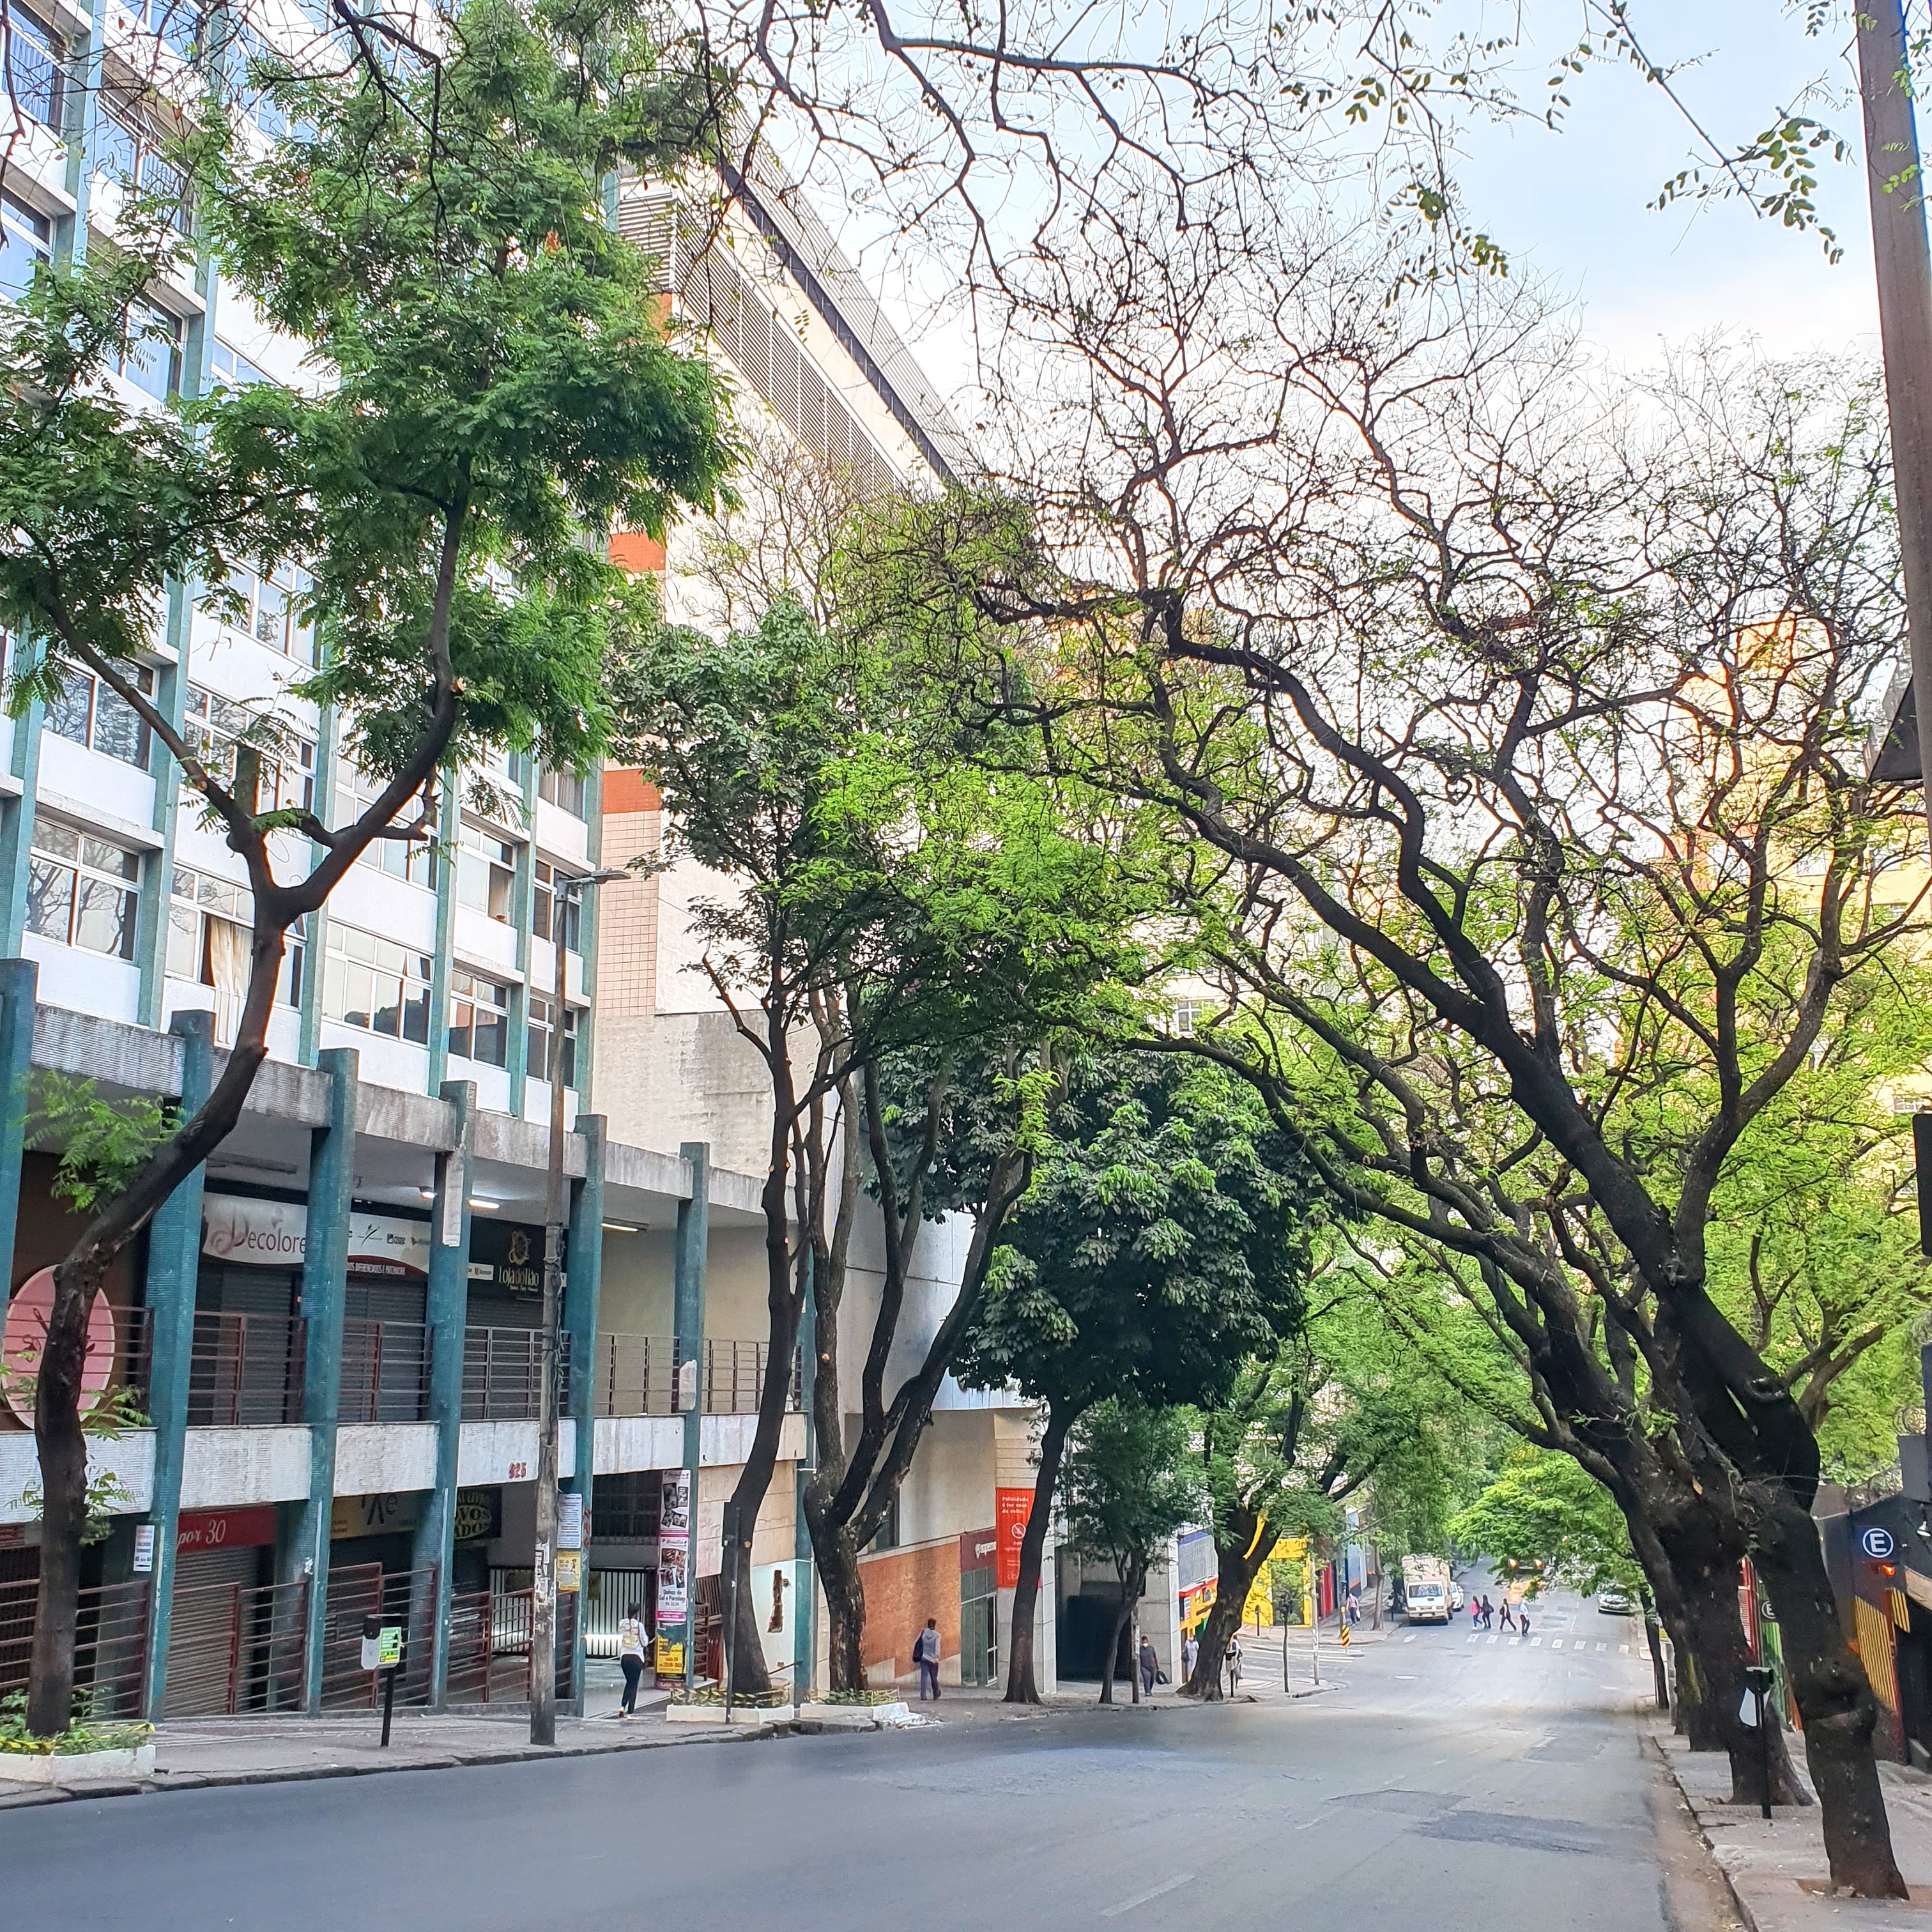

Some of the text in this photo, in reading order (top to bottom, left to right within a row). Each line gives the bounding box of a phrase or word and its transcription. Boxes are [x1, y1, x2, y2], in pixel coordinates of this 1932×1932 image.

[205, 1519, 226, 1544] 30
[1869, 1533, 1887, 1552] E
[1766, 1604, 1775, 1616] E
